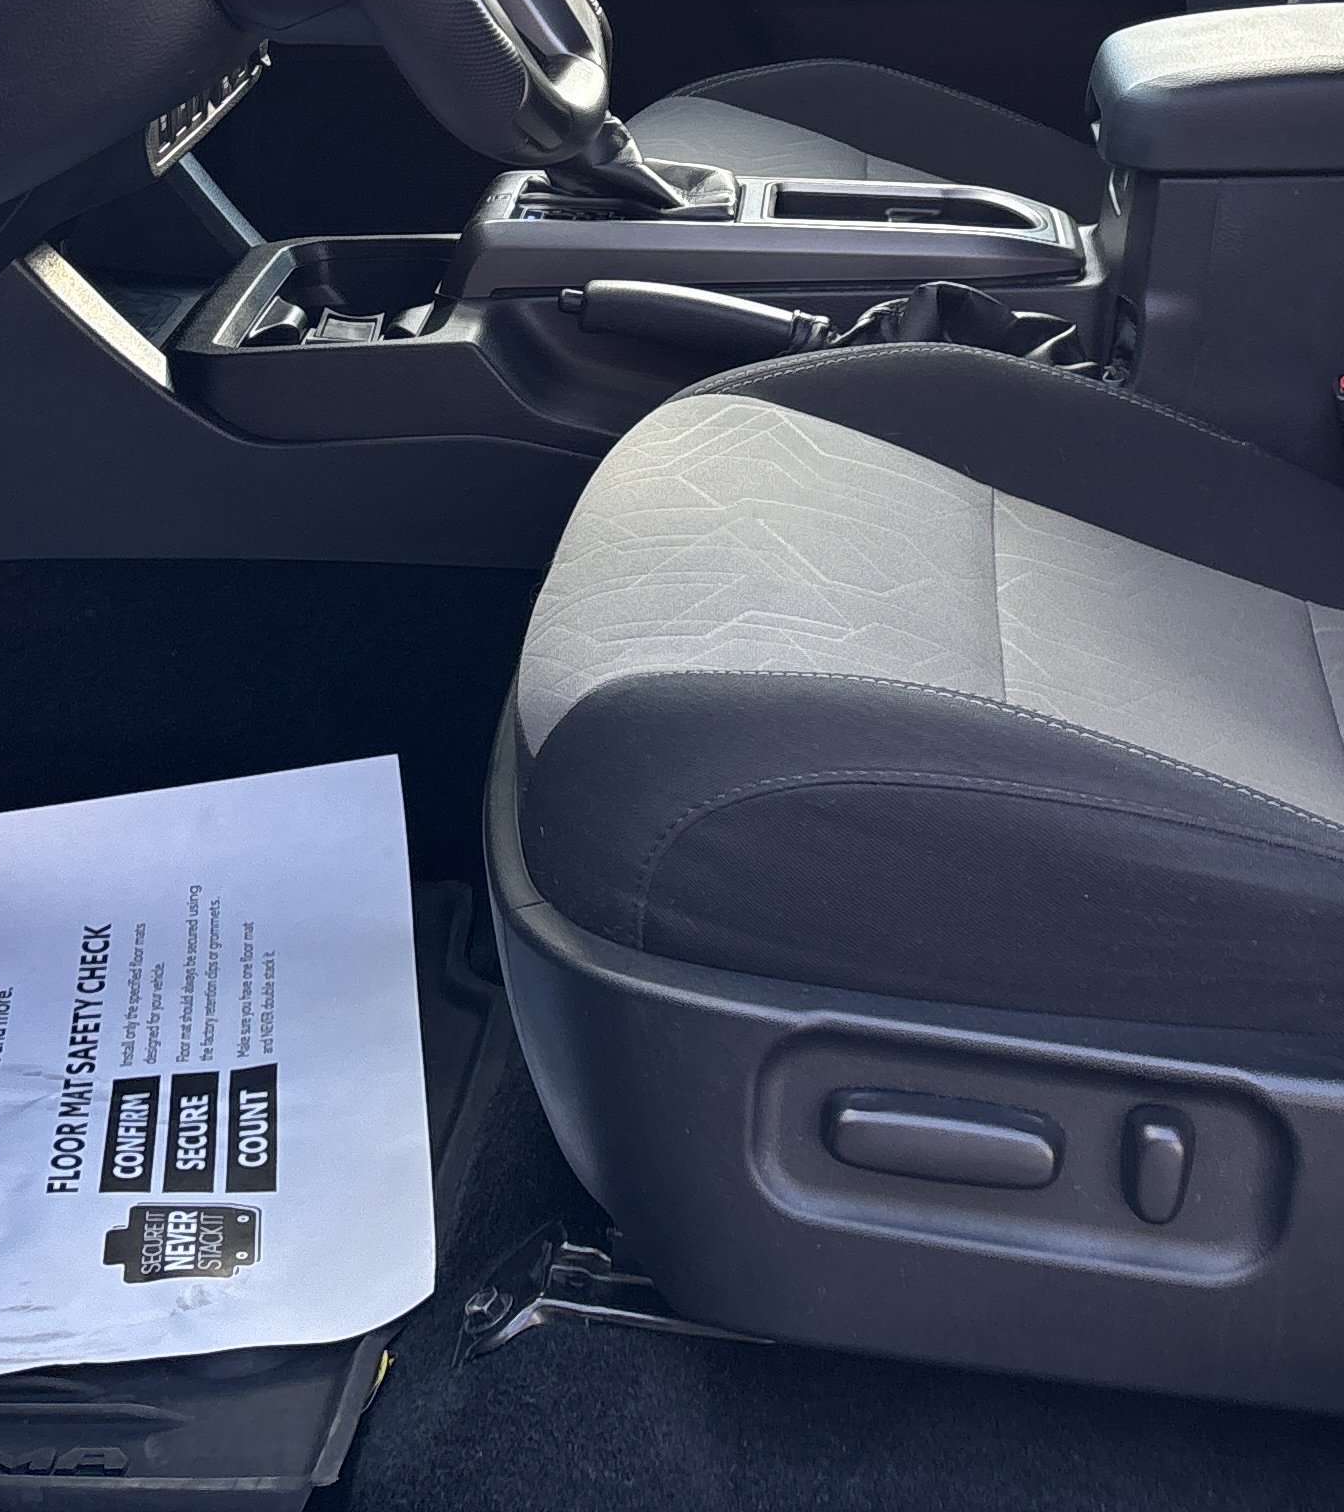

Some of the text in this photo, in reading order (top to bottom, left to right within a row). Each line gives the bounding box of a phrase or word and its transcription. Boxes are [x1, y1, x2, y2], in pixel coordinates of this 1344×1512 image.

[209, 897, 222, 949] grommets.
[176, 885, 202, 1062] Floor mat should always be secured using
[209, 950, 218, 960] or
[263, 958, 275, 980] stack
[120, 923, 146, 1067] Install only the specified floor mats
[152, 993, 164, 1010] your
[237, 922, 254, 1057] Make sure you have one floor mat
[262, 981, 275, 1010] double
[146, 1013, 160, 1024] for
[200, 1018, 218, 1046] factory
[261, 1011, 273, 1037] NEVER
[46, 924, 112, 1193] FLOOR MAT SAFETY CHECK
[144, 1026, 161, 1064] designed
[200, 1048, 213, 1061] the
[262, 1038, 273, 1054] and
[113, 1092, 151, 1179] CONFIRM
[176, 1094, 210, 1170] SECURE
[238, 1089, 269, 1167] COUNT
[140, 1211, 165, 1274] SECURE IT
[164, 1210, 198, 1272] NEVER
[198, 1212, 224, 1270] STACK IT
